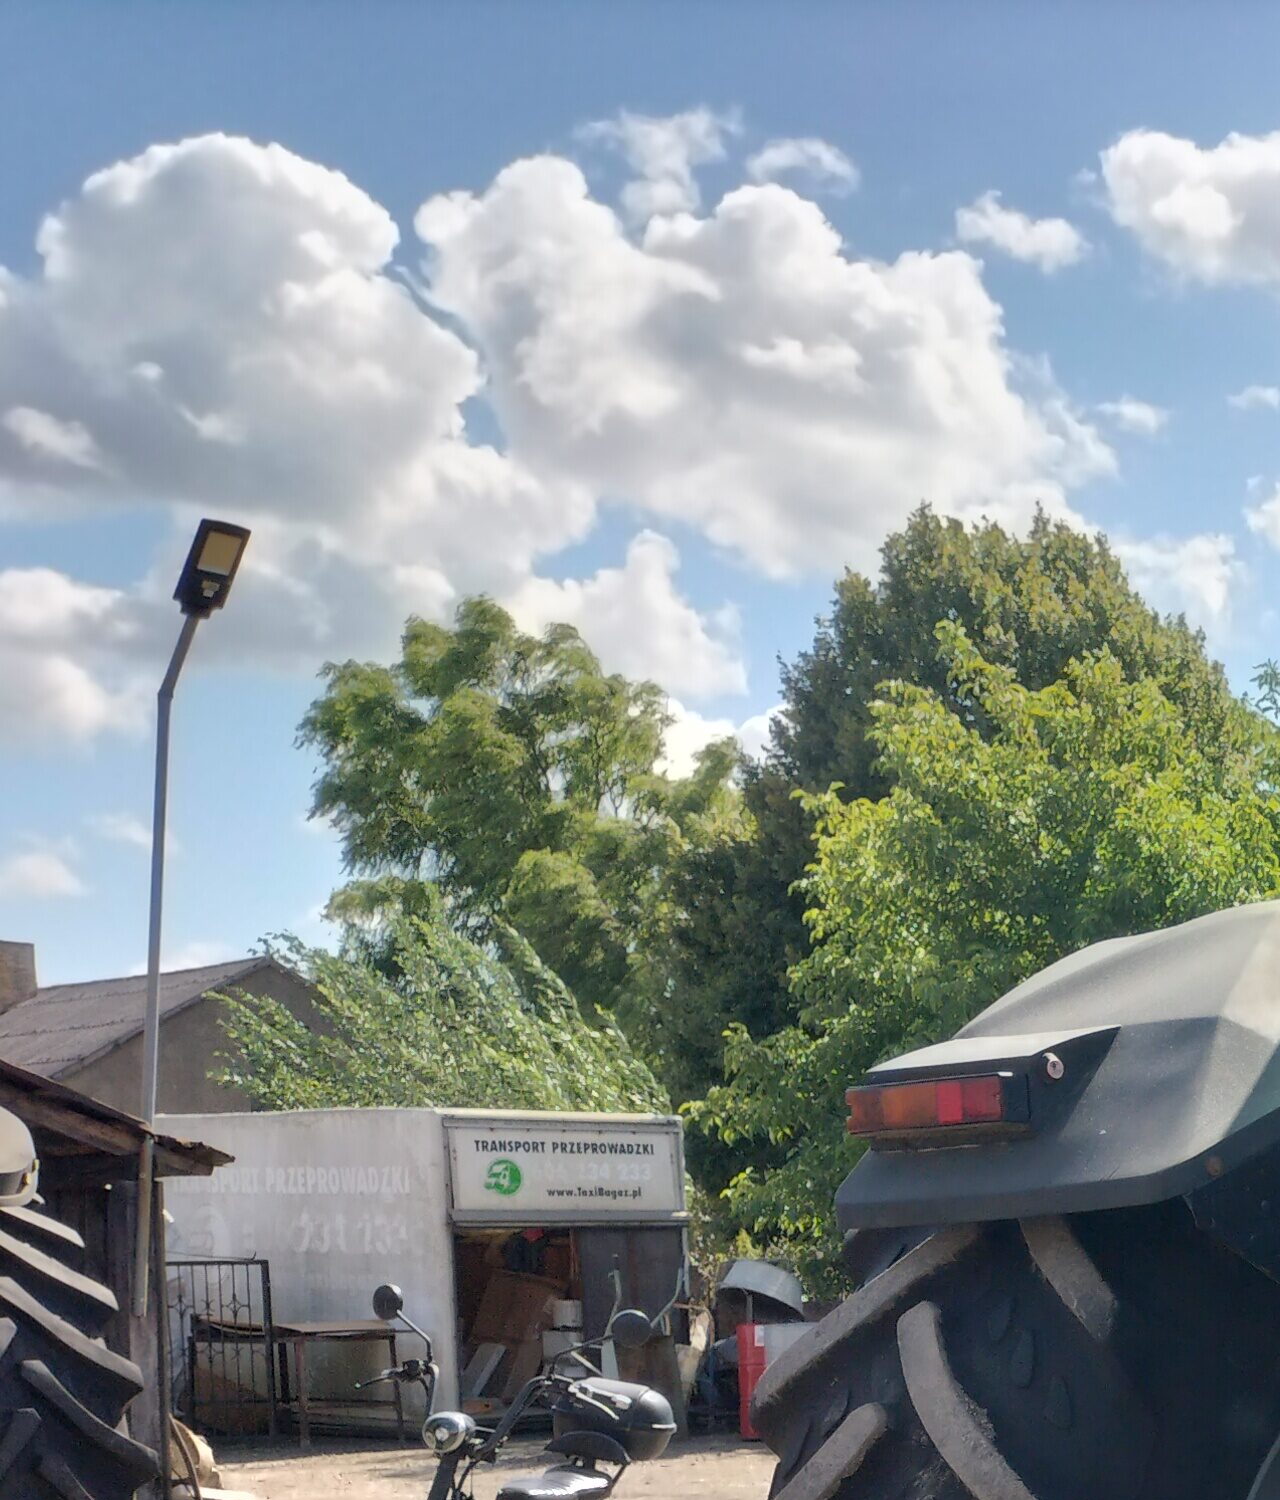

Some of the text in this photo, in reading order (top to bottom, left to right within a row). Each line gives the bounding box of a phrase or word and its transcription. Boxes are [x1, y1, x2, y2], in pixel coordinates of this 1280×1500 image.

[473, 1139, 655, 1156] TRANSPORT PRZEPROWADZKI
[265, 1166, 411, 1194] PRZEPROWADZKI
